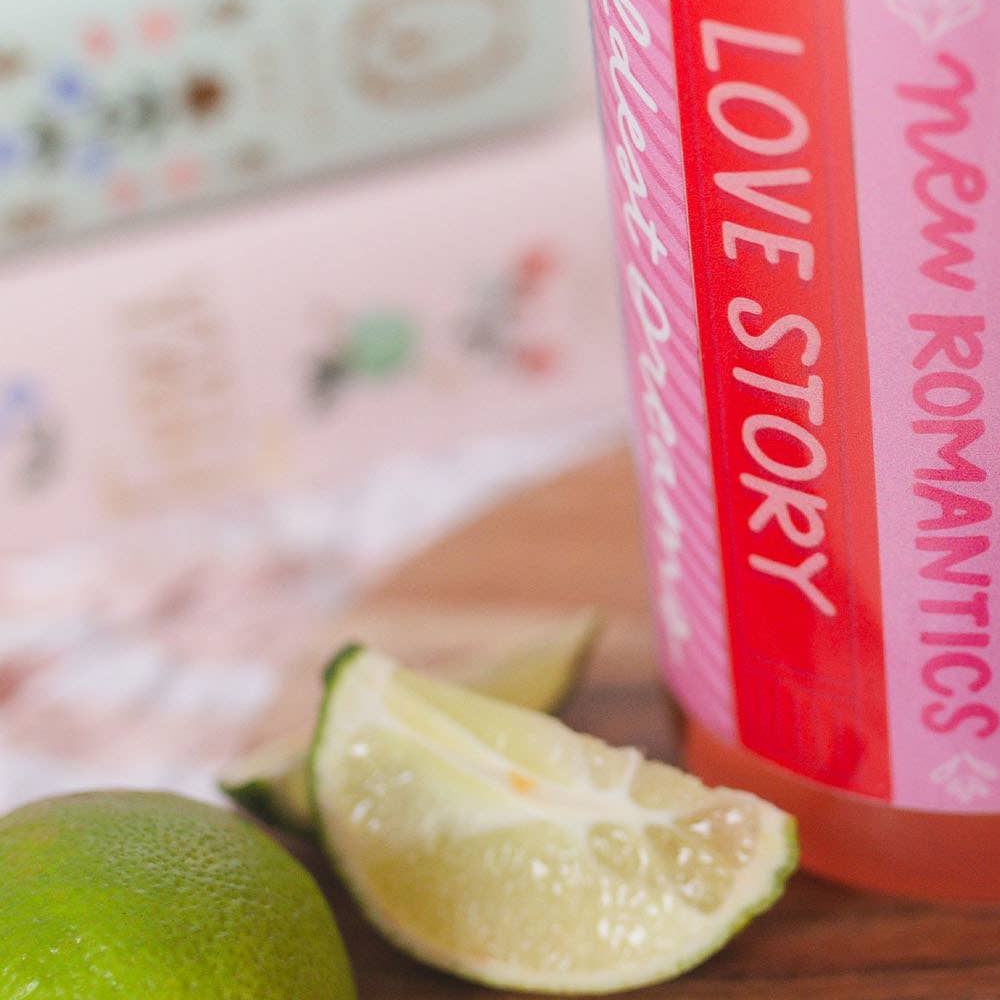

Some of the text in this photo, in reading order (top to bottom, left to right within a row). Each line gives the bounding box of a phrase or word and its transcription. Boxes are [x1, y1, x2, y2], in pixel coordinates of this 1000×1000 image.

[699, 18, 836, 618] LOVE STORY
[896, 50, 1000, 740] new ROMANTICS
